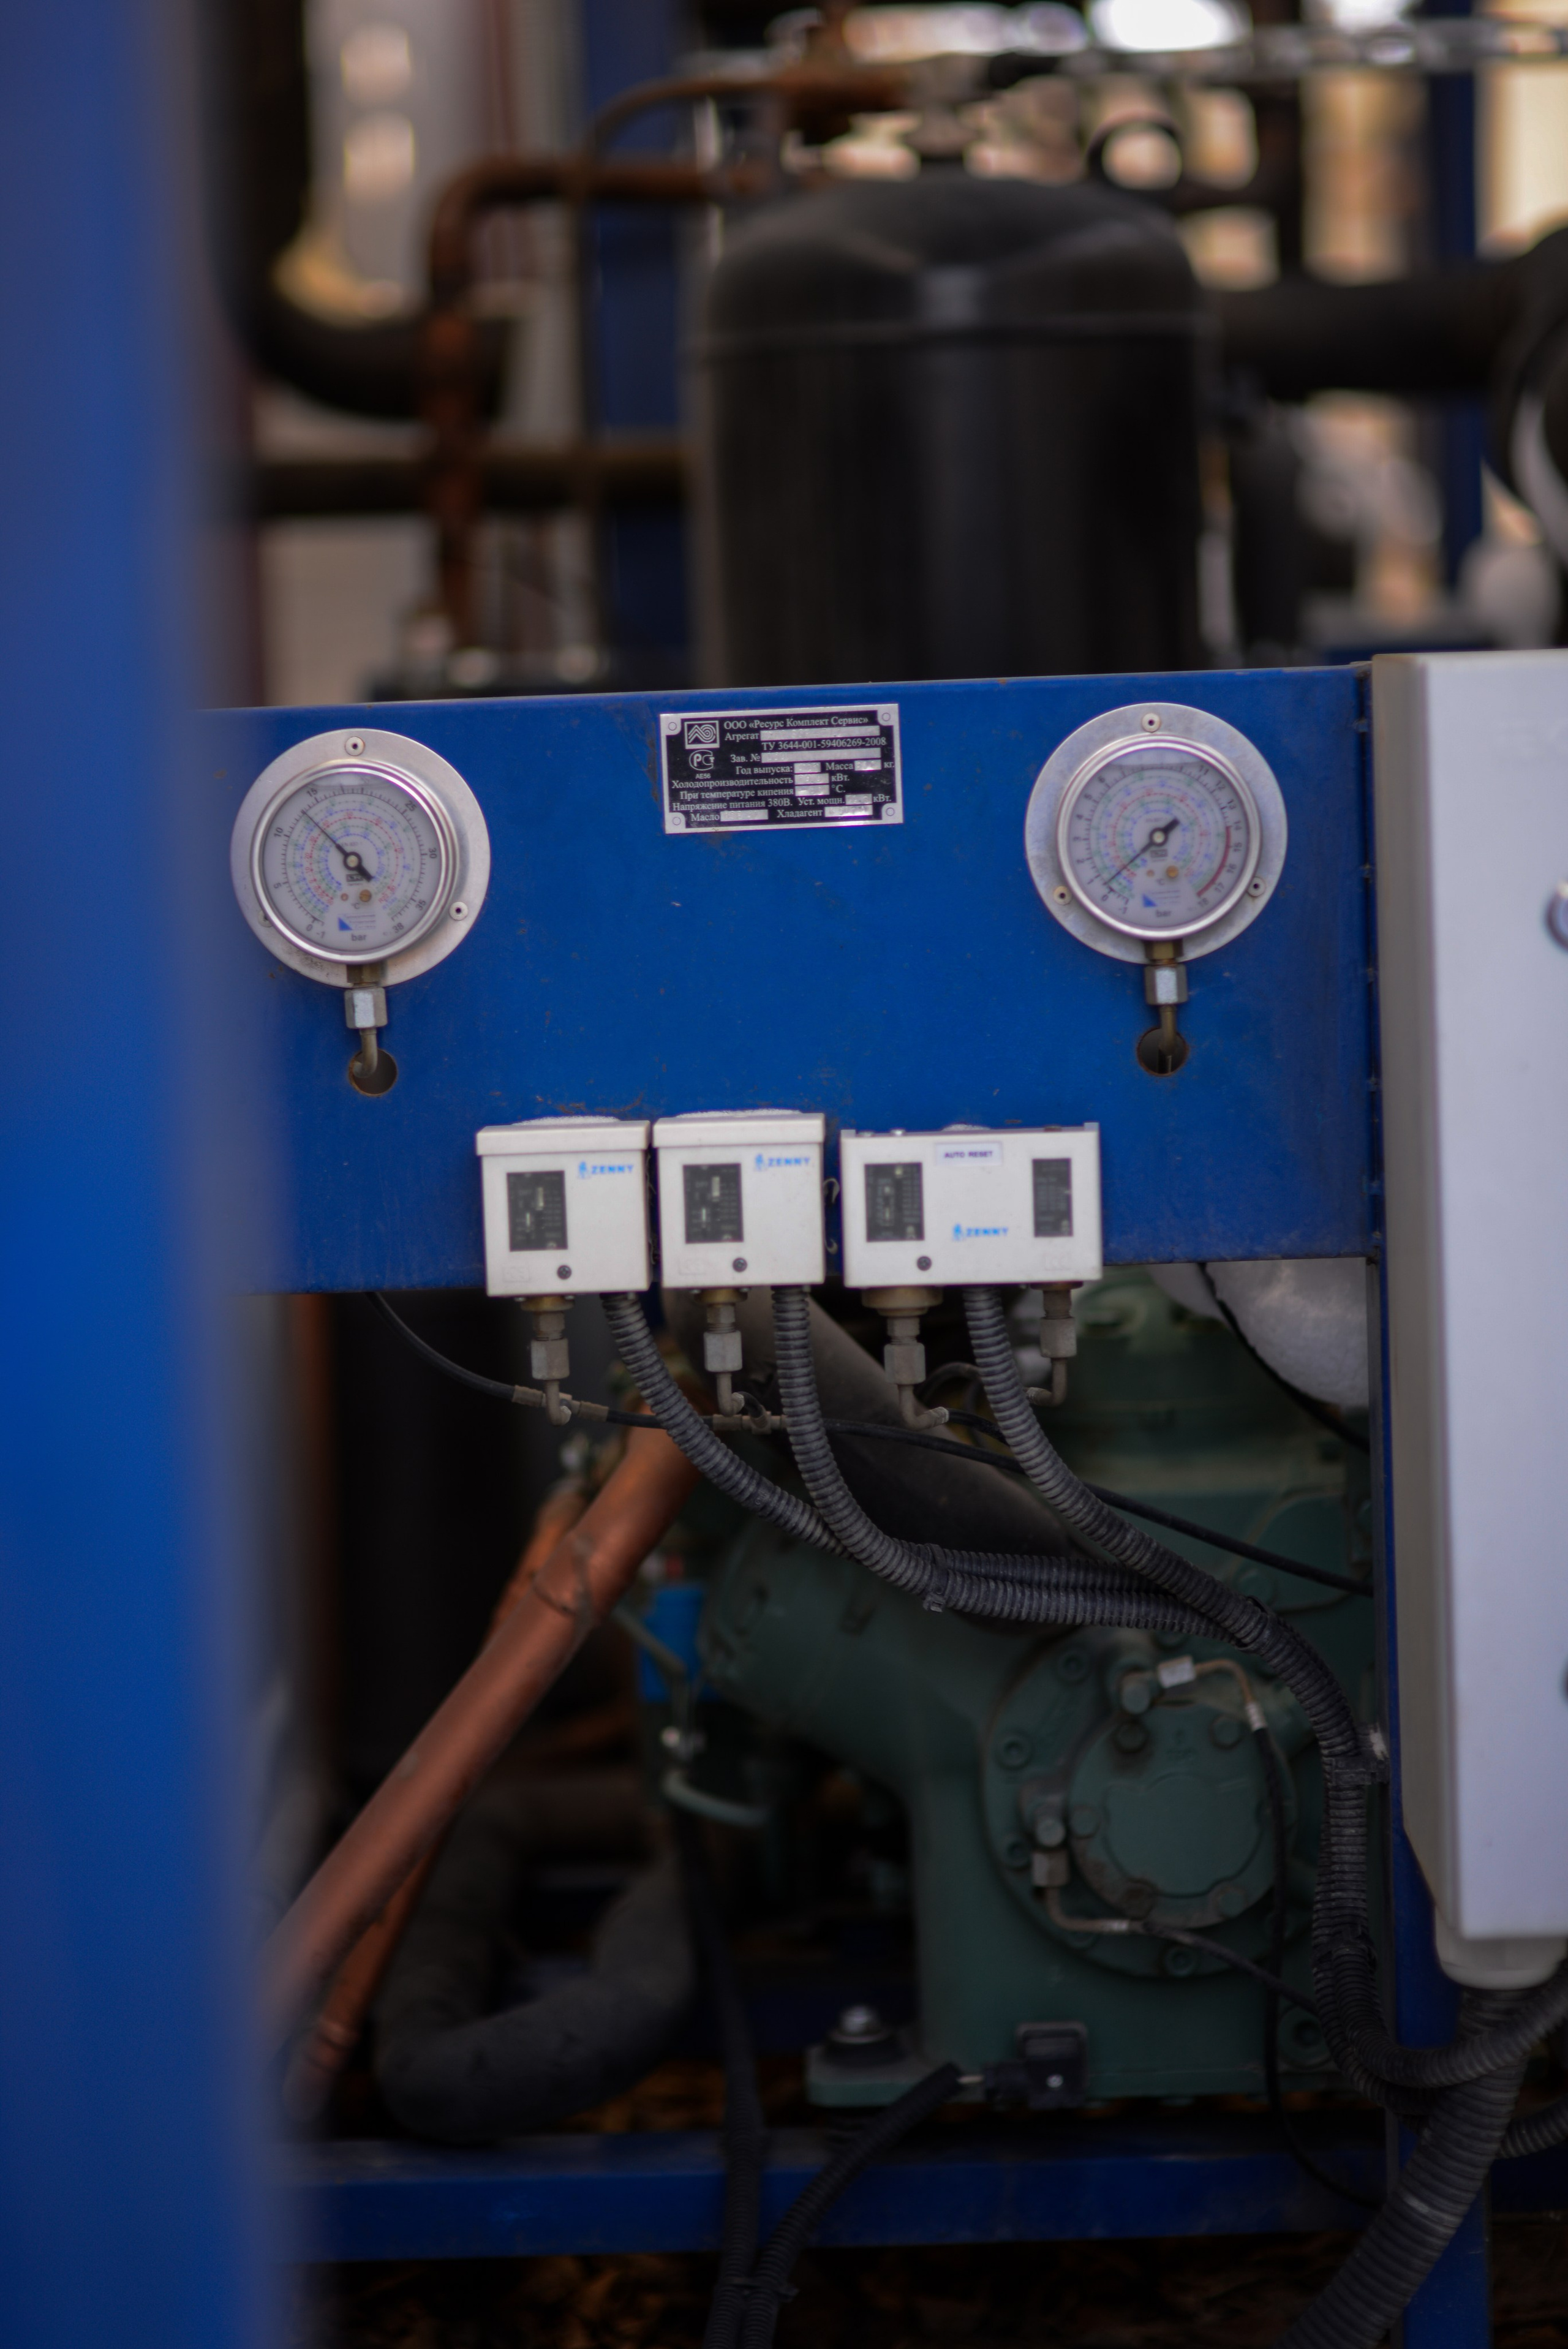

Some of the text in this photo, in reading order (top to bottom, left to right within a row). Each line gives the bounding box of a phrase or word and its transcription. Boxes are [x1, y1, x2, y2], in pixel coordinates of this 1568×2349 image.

[749, 719, 784, 729] «Ресурс
[786, 718, 829, 727] Комплект
[831, 716, 869, 726] Сервис»
[725, 733, 759, 742] Агрегат
[761, 737, 887, 751] ТУ 3644-001-59406269-2008
[730, 754, 748, 763] Зав.
[736, 766, 752, 775] Год
[753, 766, 793, 775] выпуска:
[826, 762, 854, 771] Масса
[672, 777, 793, 789] Холодопроизводительность
[831, 773, 850, 782] кВт.
[307, 788, 318, 797] 15
[680, 791, 699, 801] При
[700, 790, 755, 800] температуре
[404, 800, 418, 812] 25
[673, 802, 728, 812] Напряжение
[767, 798, 793, 807] 380В.
[797, 797, 815, 805] Уст.
[873, 794, 892, 802] кВт.
[691, 813, 720, 821] Масло
[777, 809, 823, 818] Хладагент
[274, 827, 284, 837] 10
[429, 847, 437, 859] 30
[415, 899, 426, 911] 35
[392, 922, 404, 933] 38
[767, 1156, 810, 1167] ZENNY
[591, 1164, 633, 1174] ZENNY
